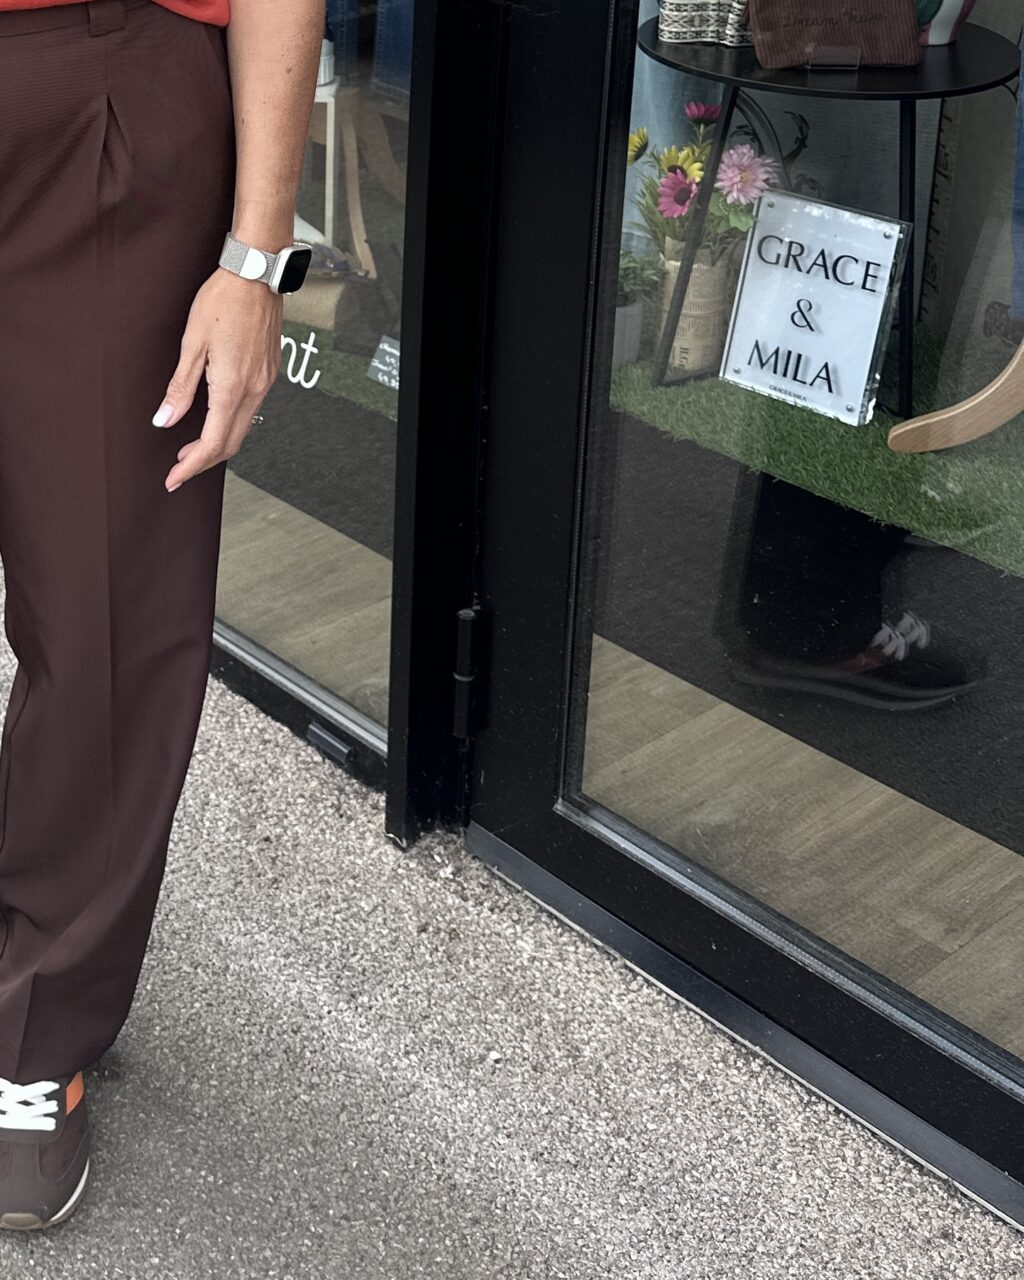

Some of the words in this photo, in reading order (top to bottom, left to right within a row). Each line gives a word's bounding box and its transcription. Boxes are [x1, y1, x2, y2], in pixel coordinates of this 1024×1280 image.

[757, 234, 882, 293] GRACE
[790, 298, 815, 332] &
[280, 331, 321, 389] nt
[747, 339, 834, 394] MILA
